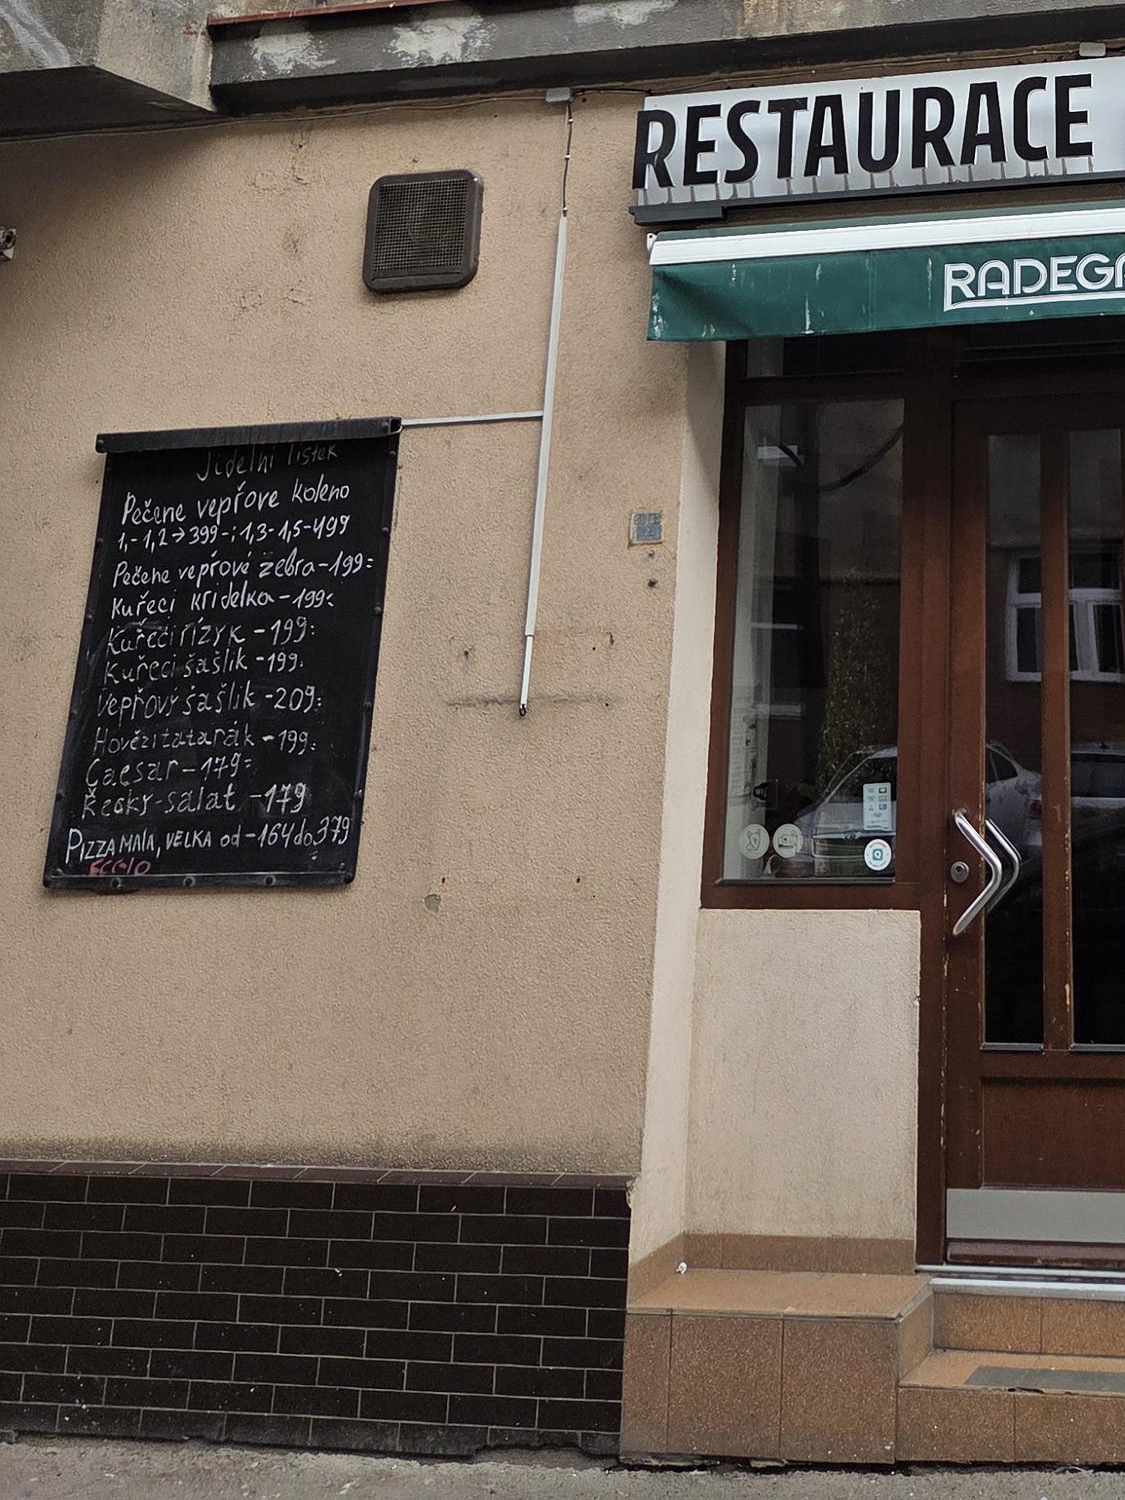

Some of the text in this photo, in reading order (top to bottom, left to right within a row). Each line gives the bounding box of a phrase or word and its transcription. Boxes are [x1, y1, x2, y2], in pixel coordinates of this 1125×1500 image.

[631, 73, 1094, 190] RESTAURACE
[196, 443, 338, 482] Jidelni listek
